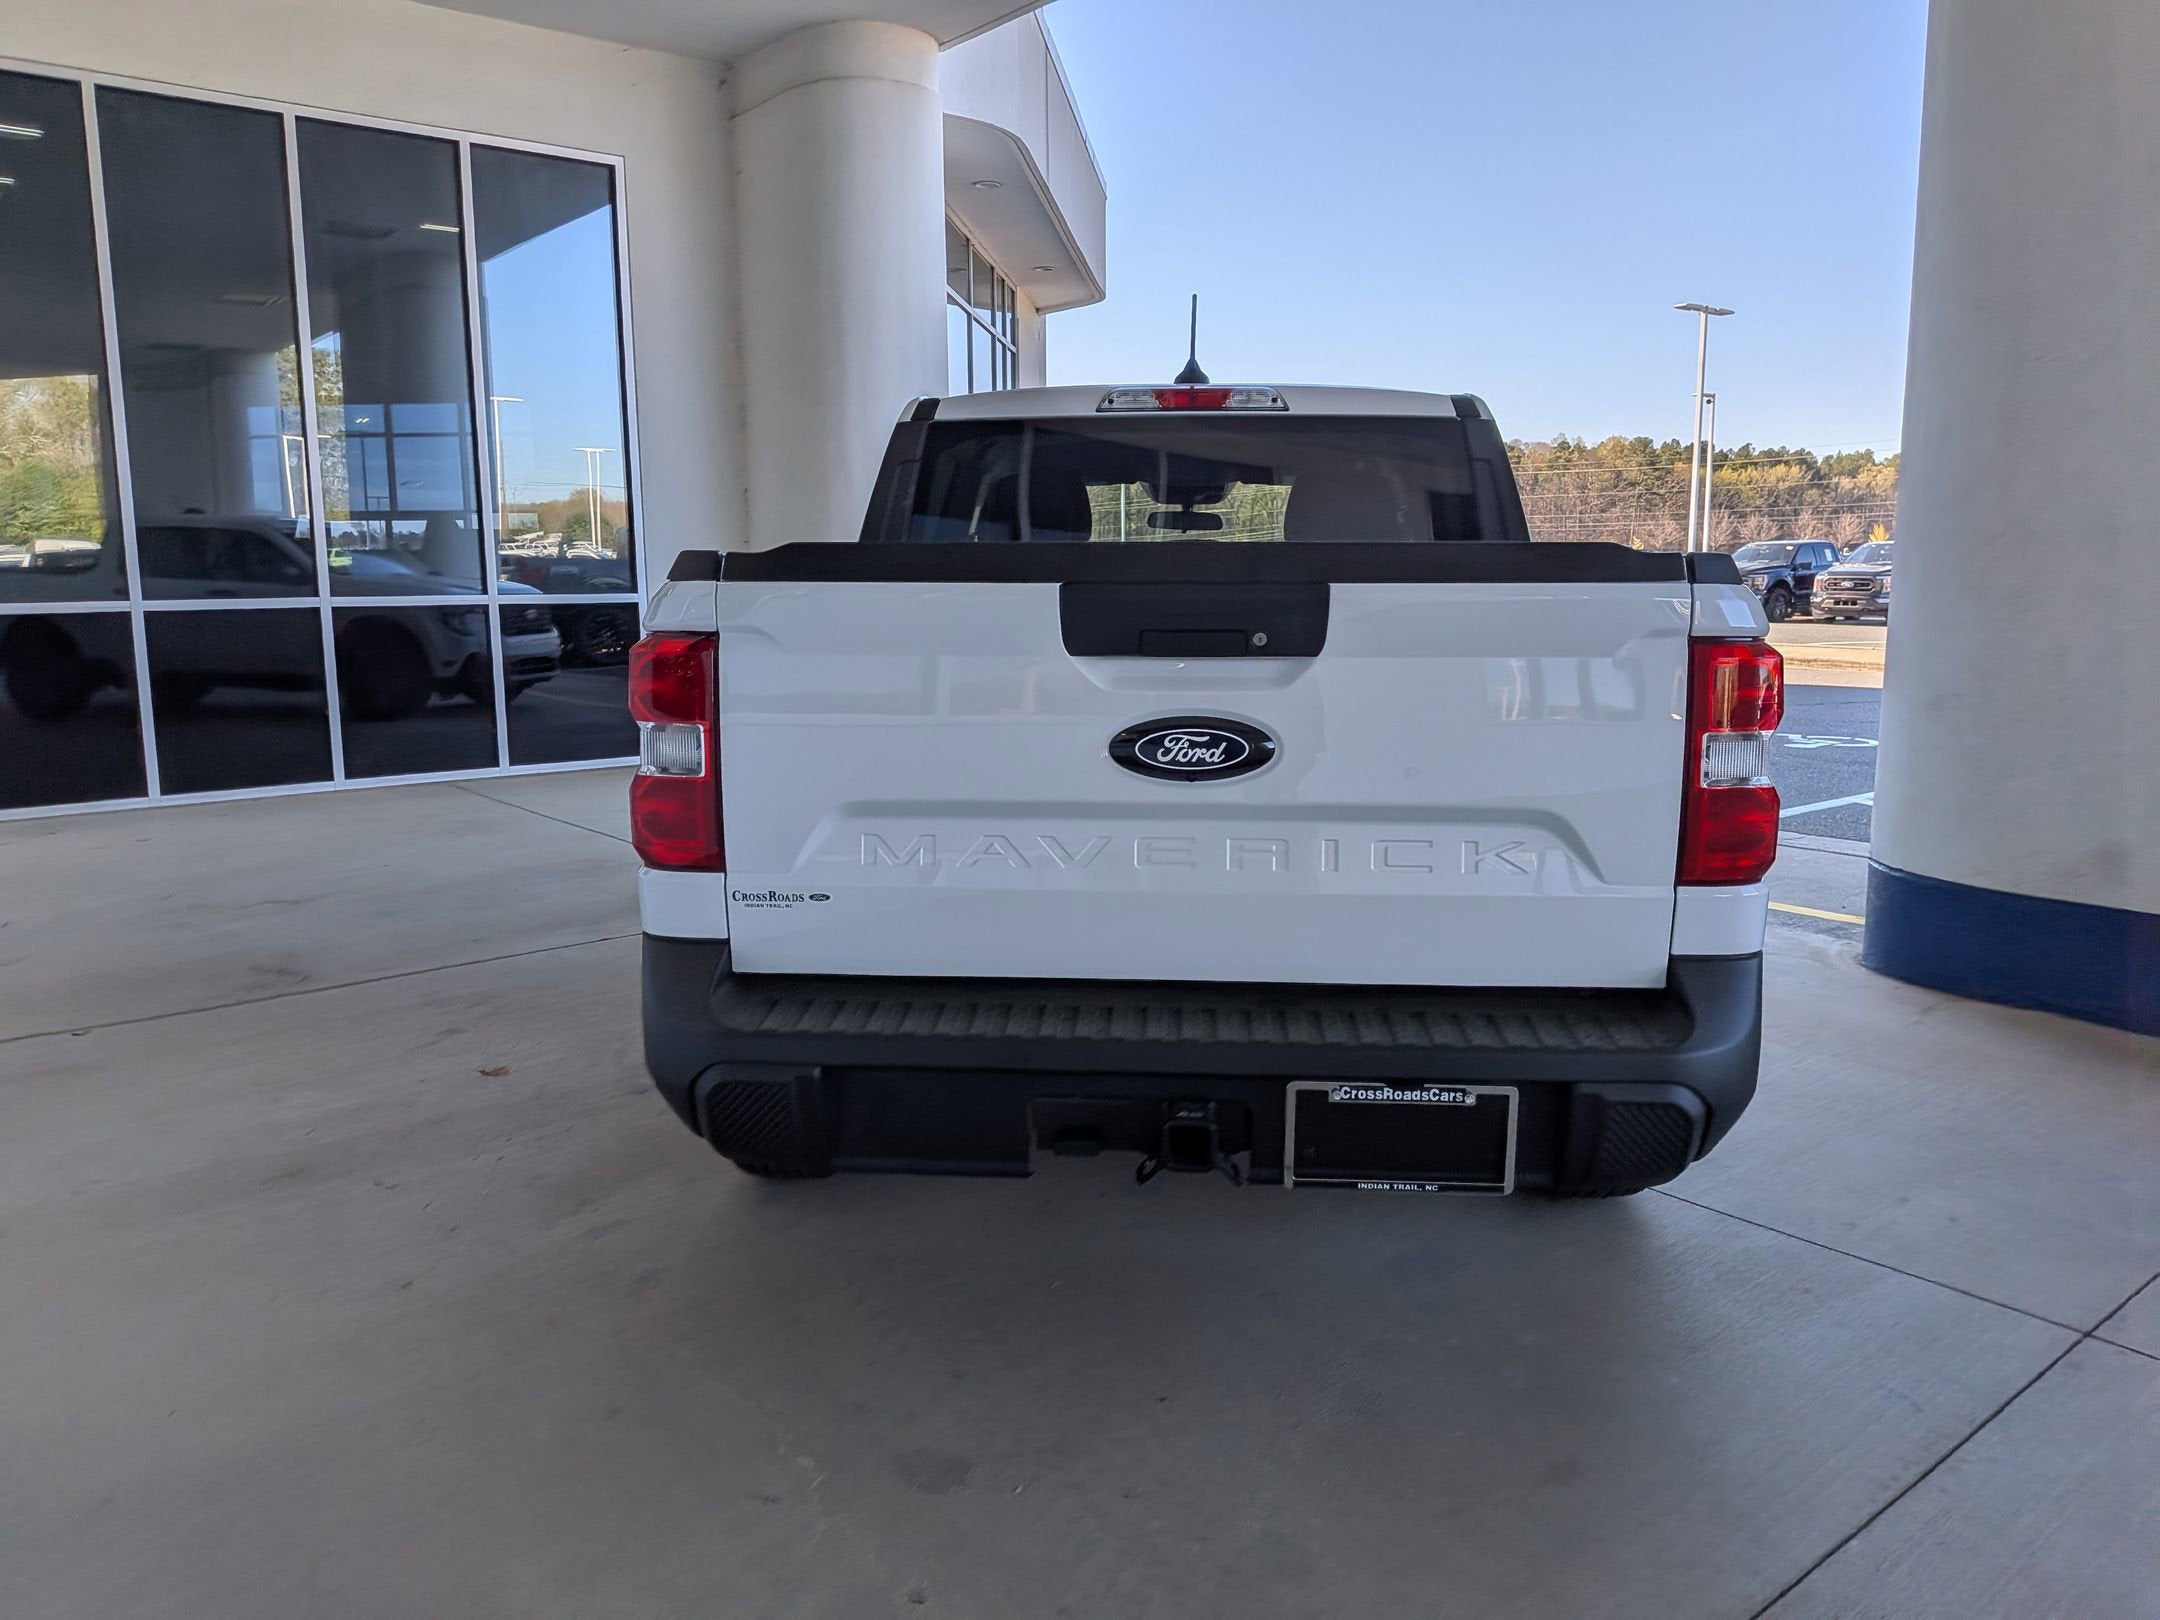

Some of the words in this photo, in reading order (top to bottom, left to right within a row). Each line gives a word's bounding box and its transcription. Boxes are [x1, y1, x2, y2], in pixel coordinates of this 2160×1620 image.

[1157, 734, 1227, 763] Ford
[859, 833, 1530, 875] MAVERICK
[1340, 1086, 1464, 1102] CrossRoadsCars
